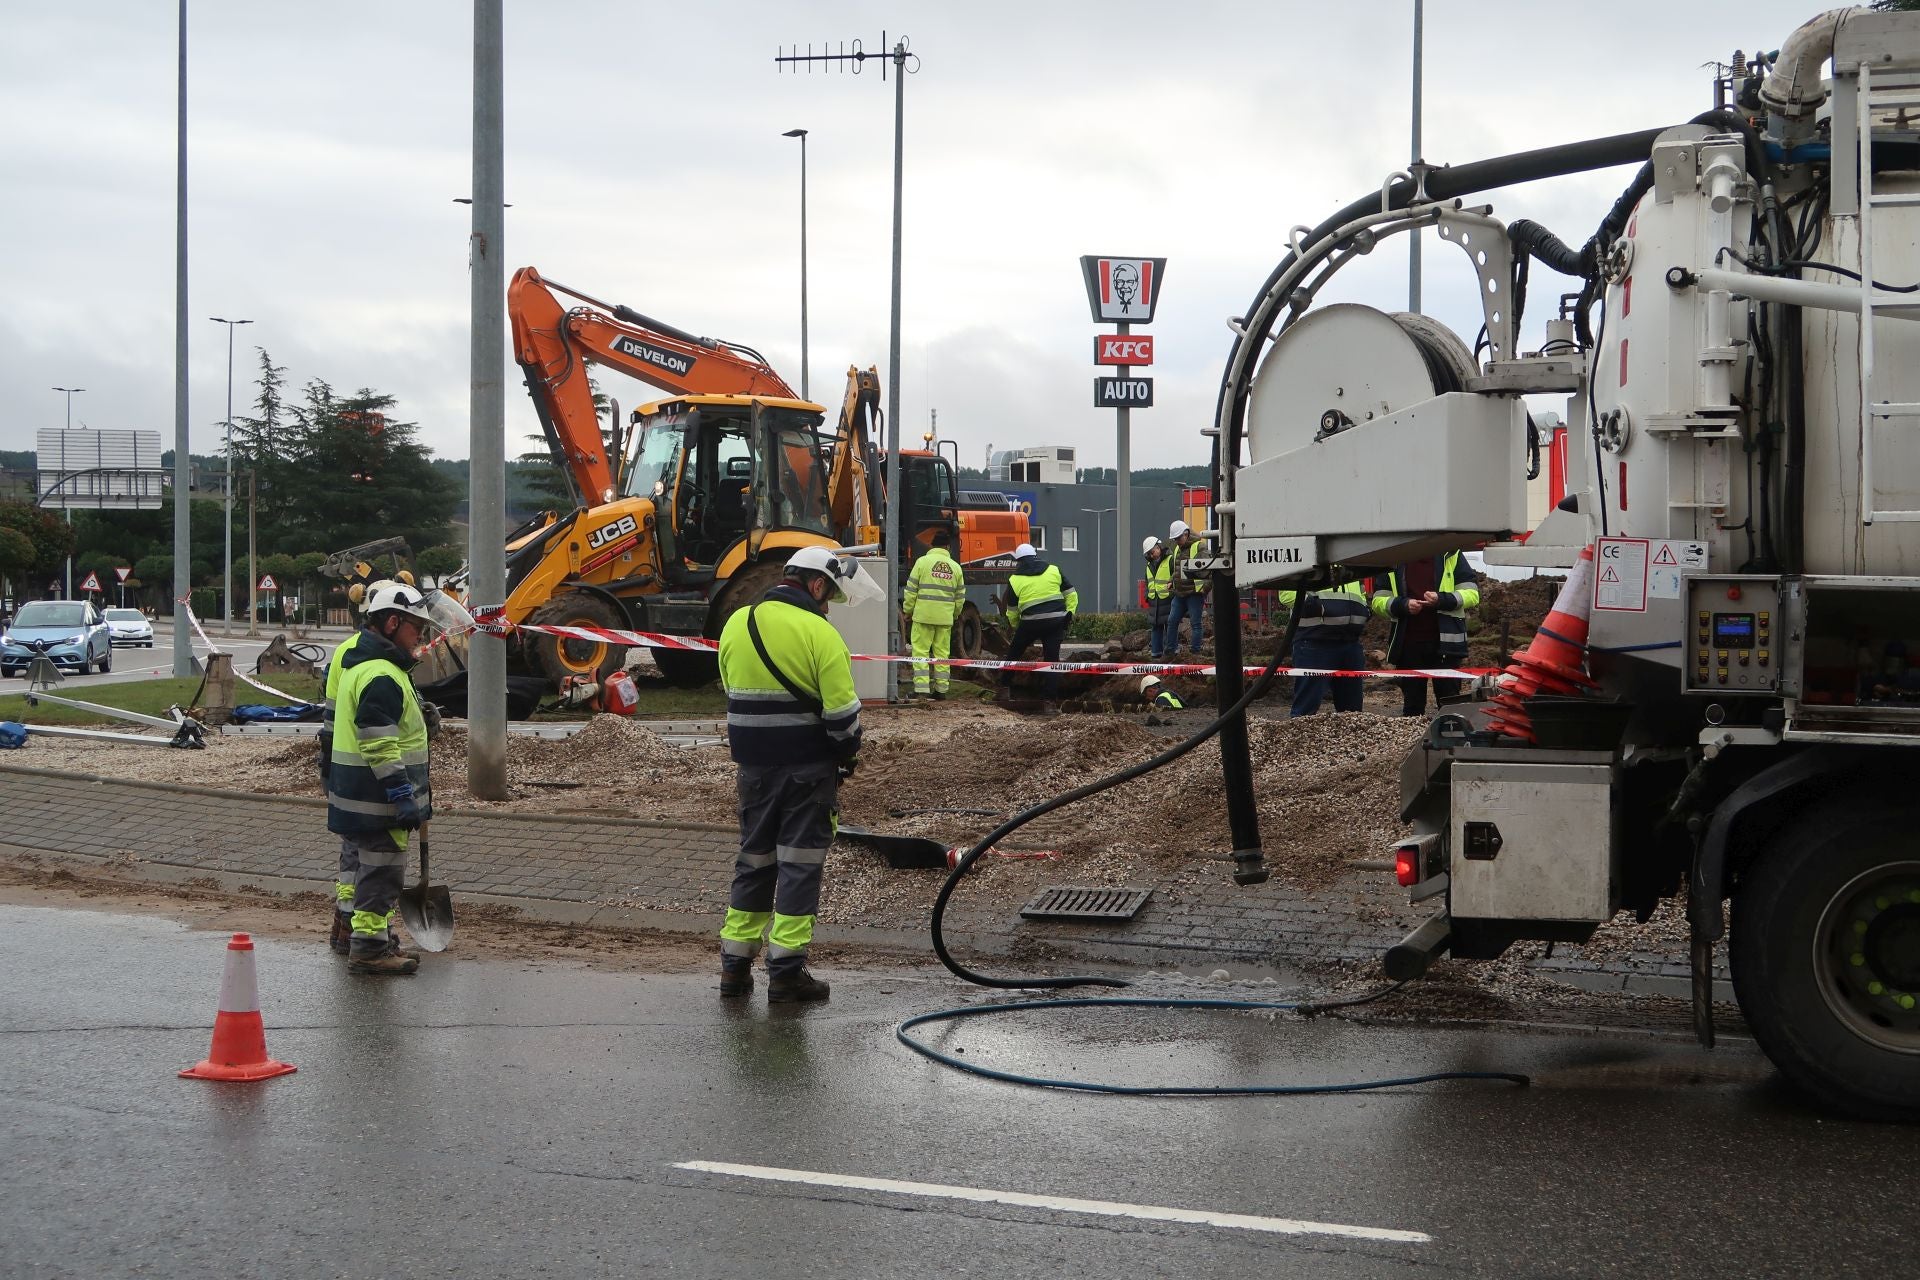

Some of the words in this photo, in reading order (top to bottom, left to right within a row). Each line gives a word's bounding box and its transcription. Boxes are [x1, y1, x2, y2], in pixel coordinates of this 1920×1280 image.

[623, 341, 687, 373] DEVELON
[1103, 341, 1150, 358] KFC
[1104, 381, 1148, 399] AUTO
[590, 516, 637, 548] JCB
[1247, 548, 1303, 563] RIGUAL
[1603, 546, 1619, 558] CE
[1132, 665, 1164, 673] SERVICIO
